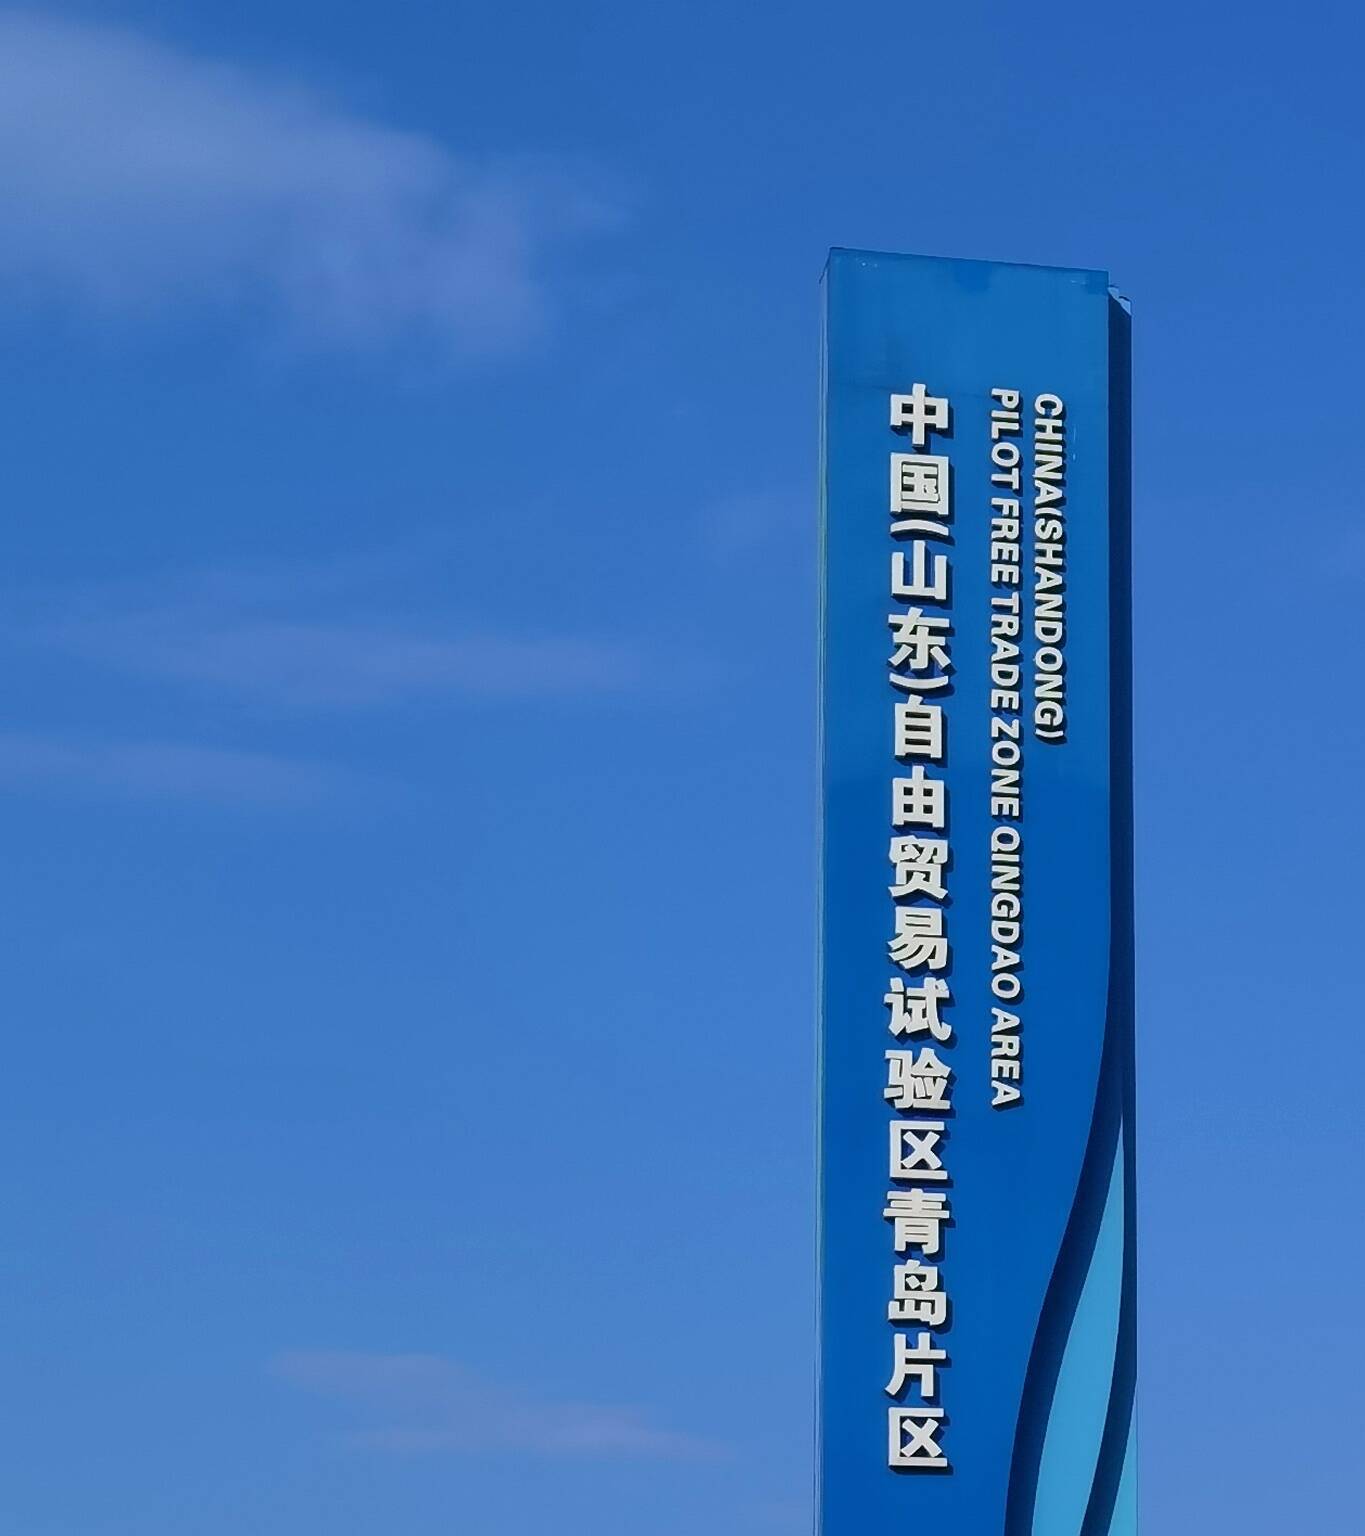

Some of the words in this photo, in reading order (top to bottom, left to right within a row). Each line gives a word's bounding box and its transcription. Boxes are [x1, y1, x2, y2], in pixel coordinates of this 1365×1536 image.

[990, 387, 1020, 490] PILOT
[990, 497, 1020, 584] FREE
[1033, 393, 1065, 739] CHINA(SHANDONG)
[990, 592, 1020, 710] TRADE
[990, 717, 1020, 817] ZONE
[883, 383, 951, 1467] 中国(山东)自由贸易试验区青岛片区
[990, 825, 1021, 999] QINGDAO
[990, 1006, 1021, 1107] AREA
